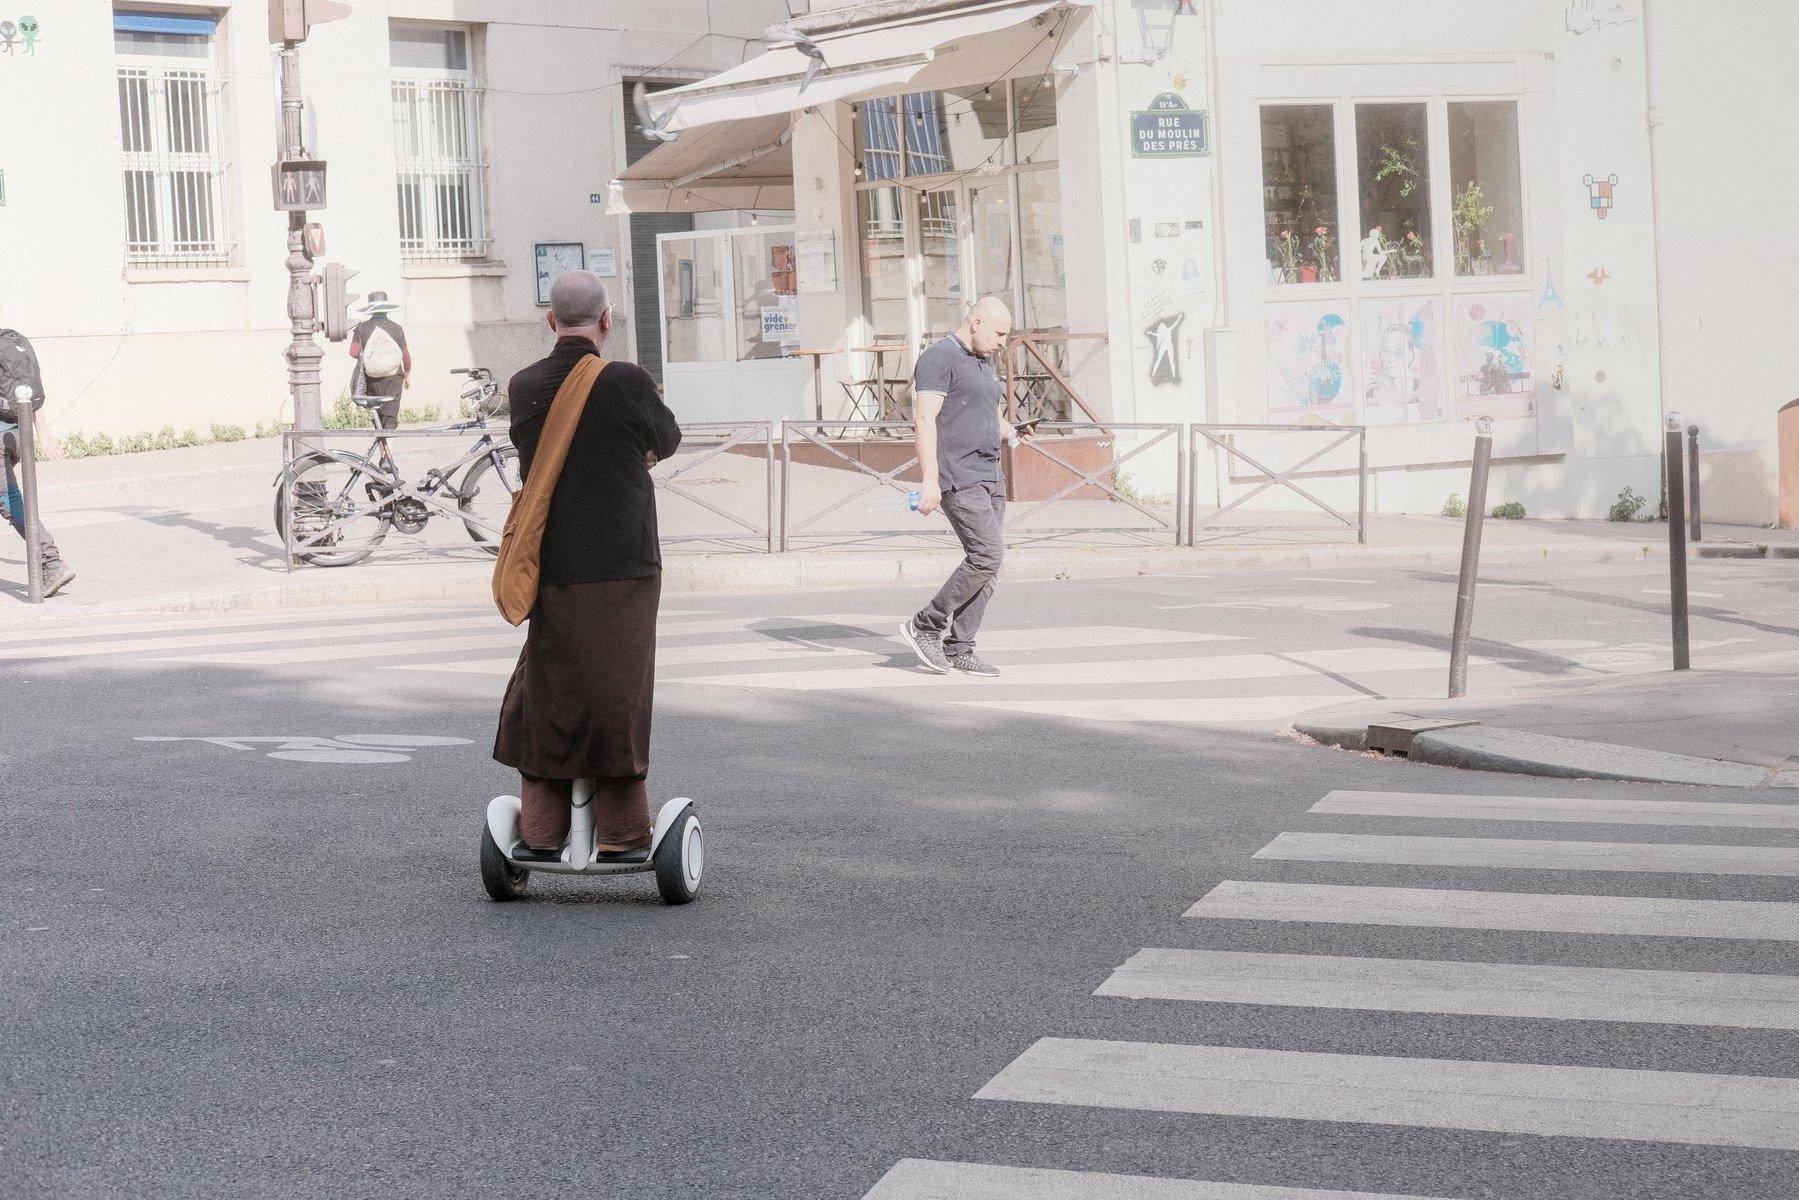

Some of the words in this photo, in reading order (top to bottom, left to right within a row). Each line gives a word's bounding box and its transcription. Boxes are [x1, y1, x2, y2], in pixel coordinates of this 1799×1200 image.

[1158, 117, 1180, 128] RUE
[1139, 129, 1154, 139] DU
[1157, 128, 1200, 139] MOULIN
[1143, 141, 1166, 151] DES
[764, 313, 784, 323] vide
